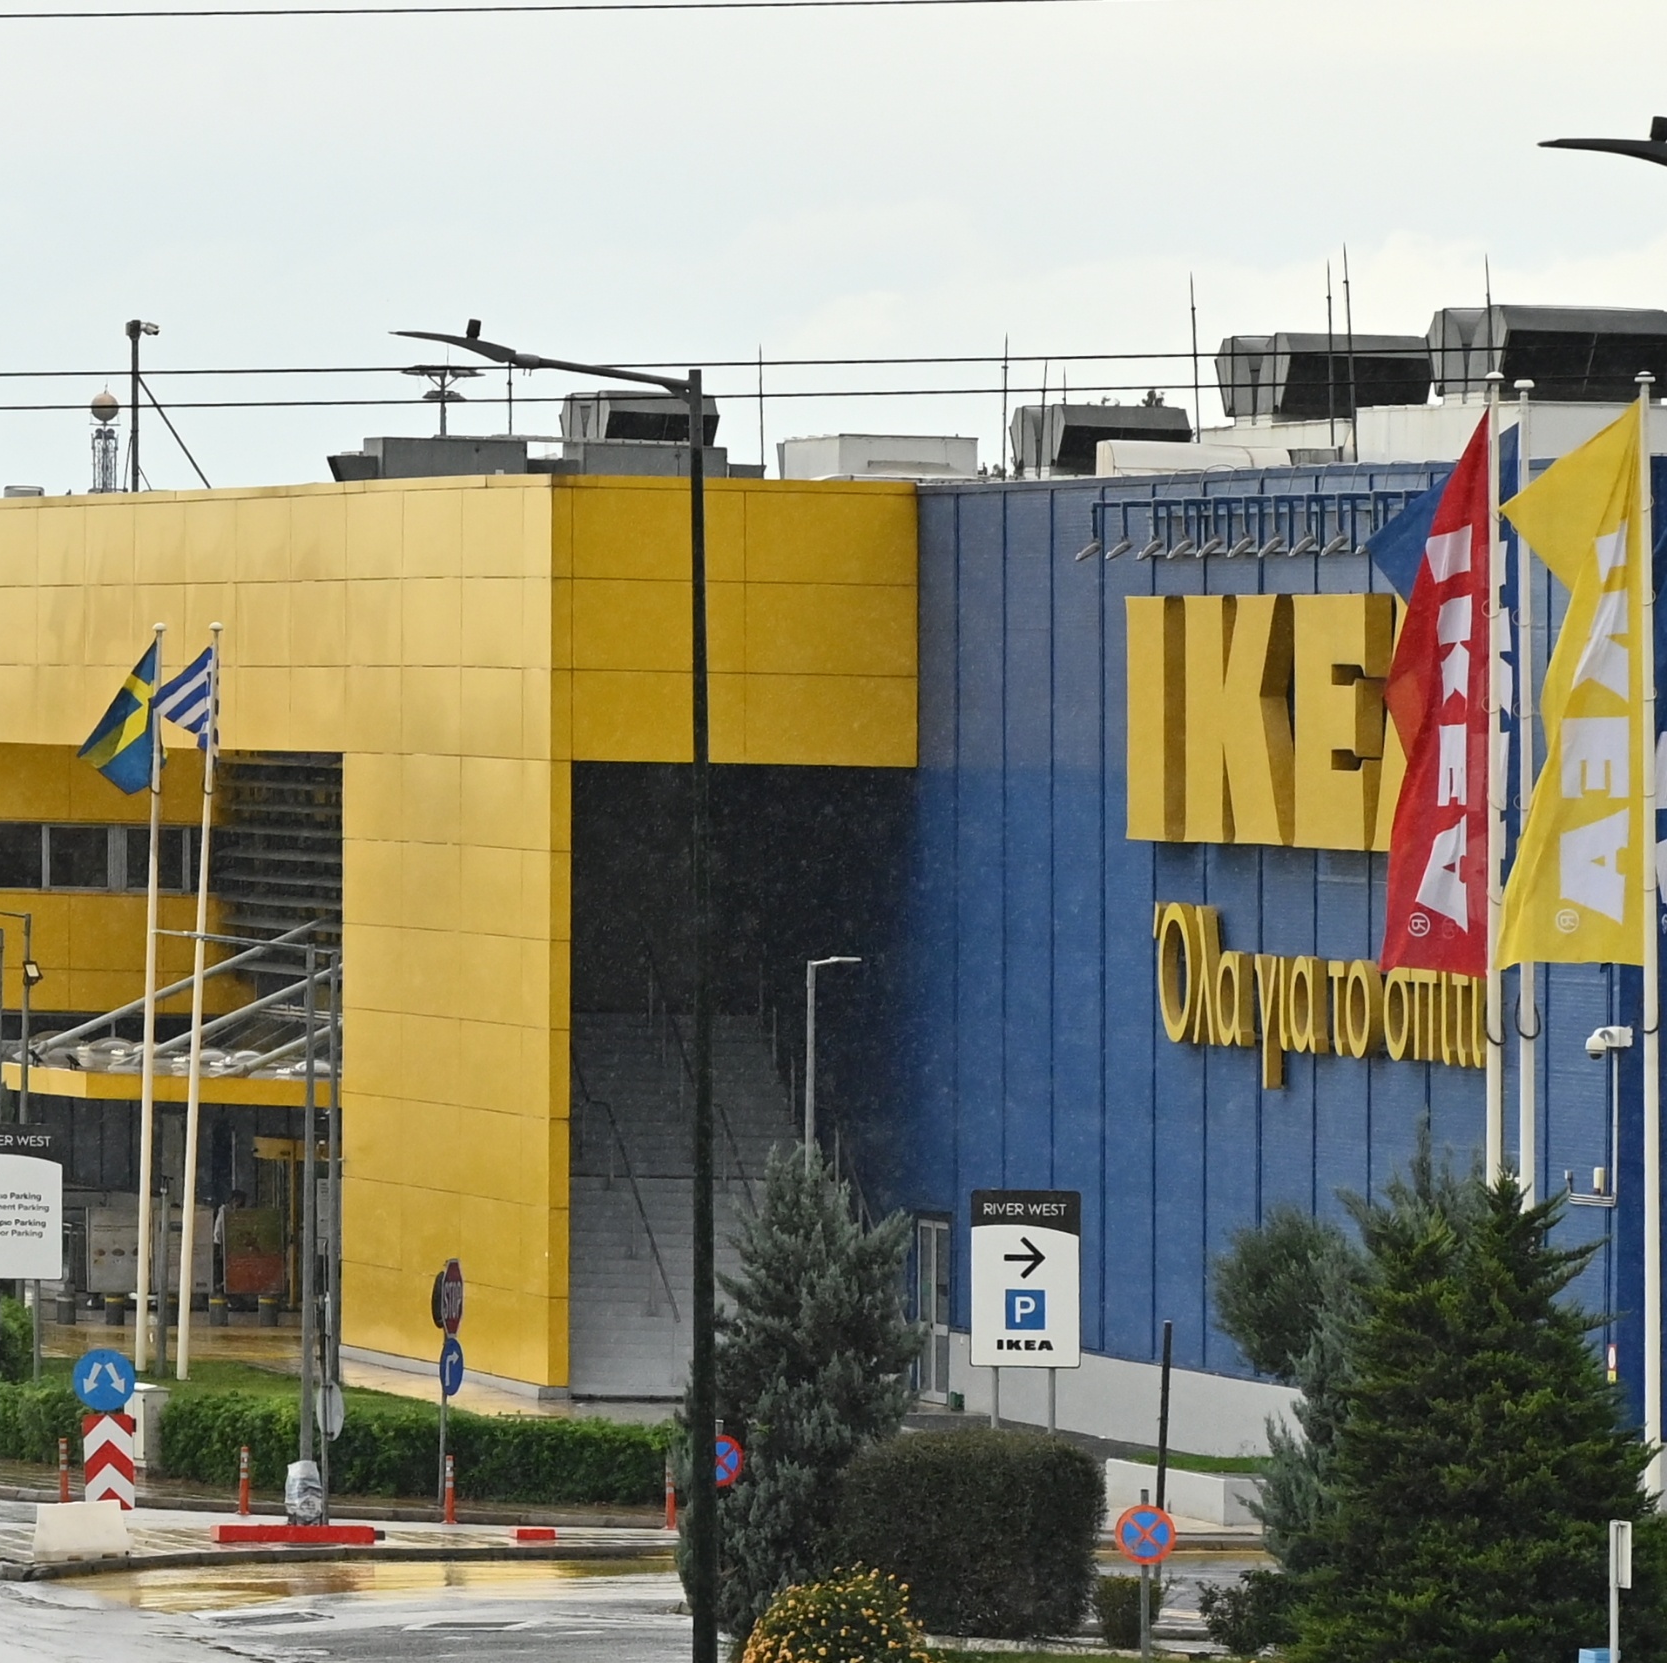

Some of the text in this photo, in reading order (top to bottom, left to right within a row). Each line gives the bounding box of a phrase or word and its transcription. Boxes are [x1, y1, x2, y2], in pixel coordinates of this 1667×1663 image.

[1126, 594, 1405, 851] IKE
[1153, 901, 1249, 1047] Όλα
[1254, 954, 1327, 1089] για
[1328, 959, 1379, 1060] το
[17, 1135, 52, 1148] WEST
[10, 1191, 42, 1202] Parking
[18, 1203, 50, 1213] Parking
[983, 1202, 1067, 1217] RIVER WEST
[15, 1218, 47, 1229] Parking
[11, 1229, 44, 1239] Parking
[444, 1281, 462, 1319] STOP
[1015, 1296, 1036, 1323] P
[997, 1339, 1054, 1351] IKEA
